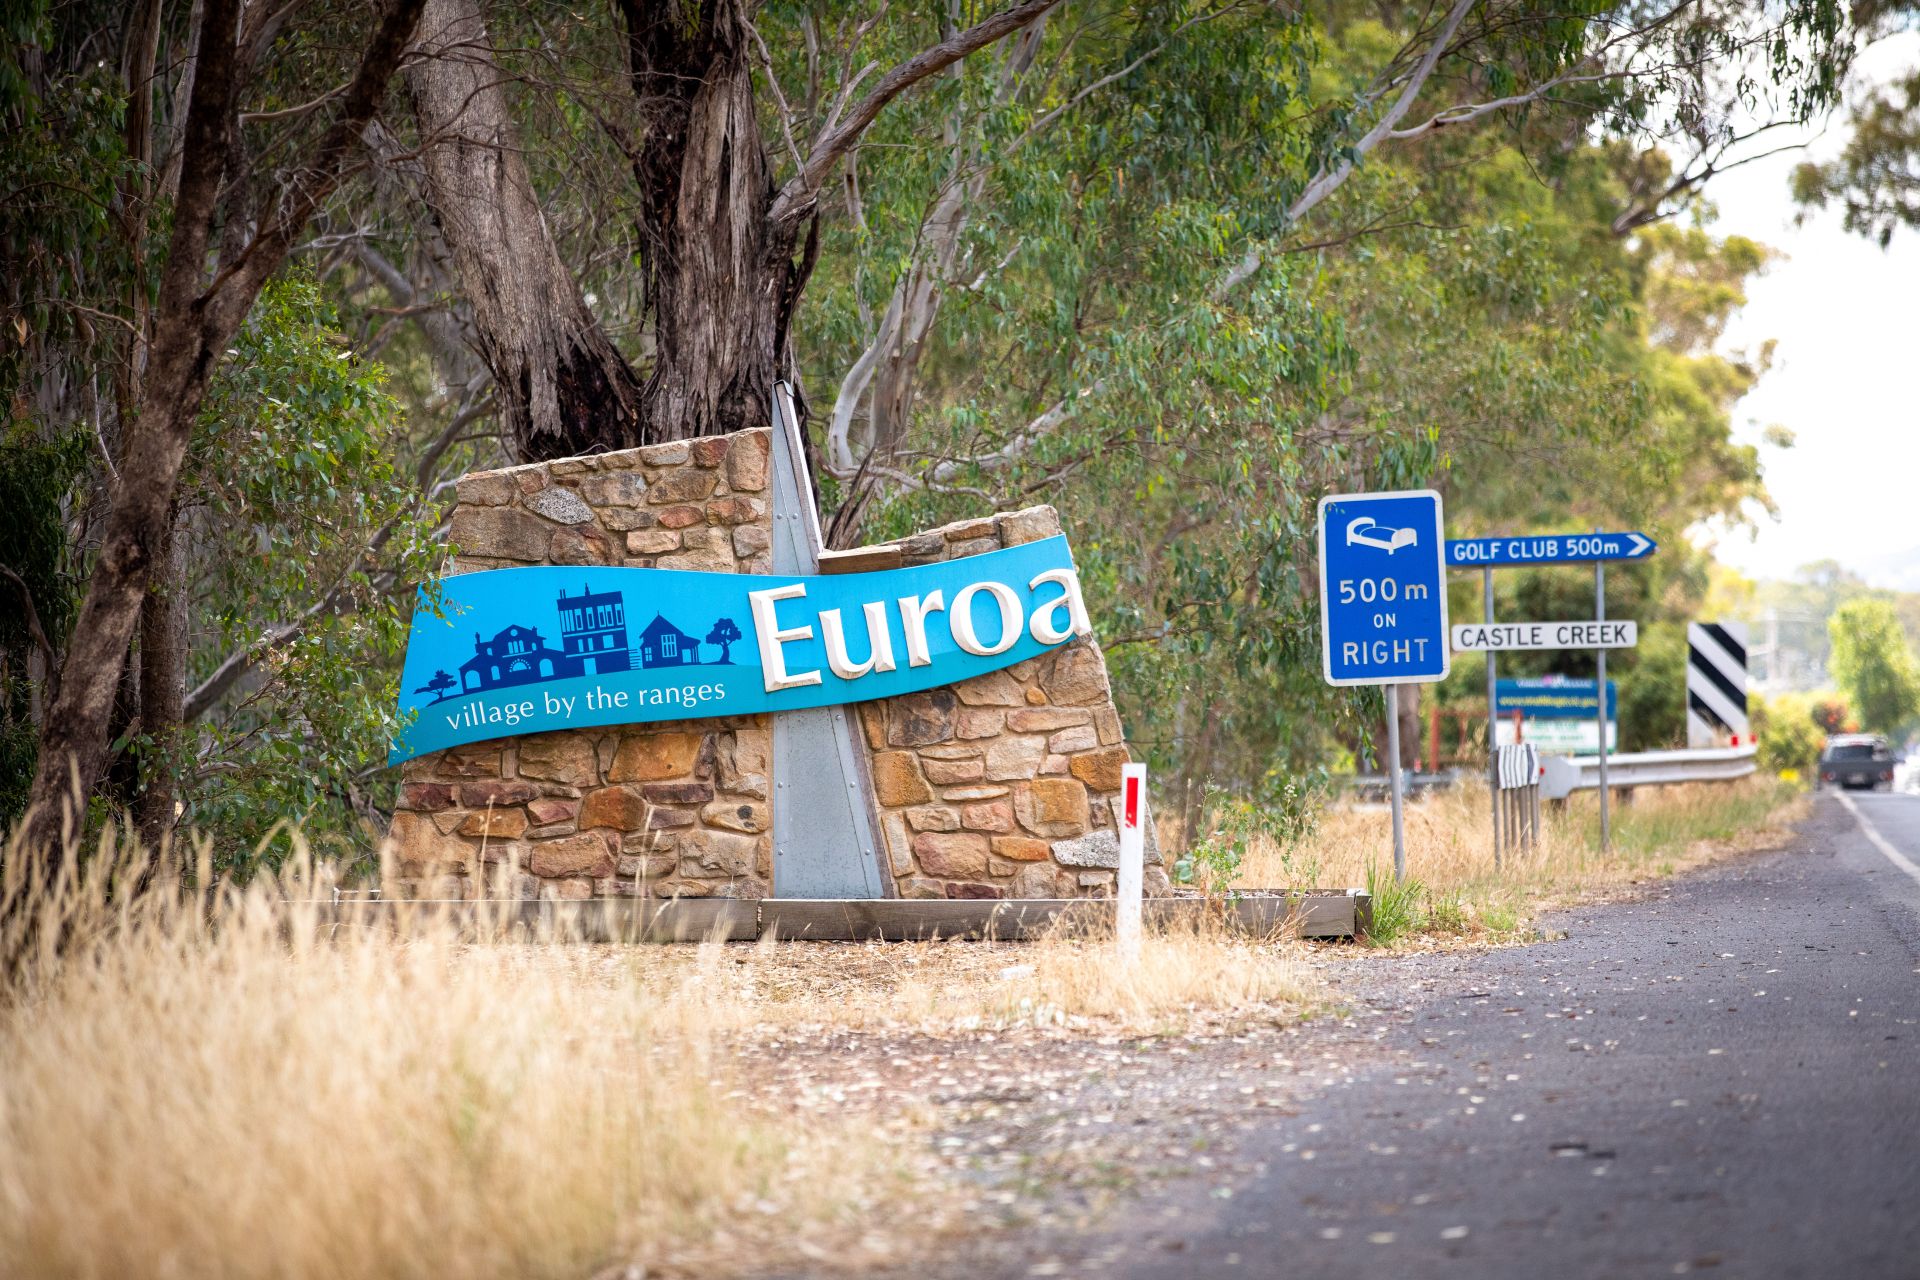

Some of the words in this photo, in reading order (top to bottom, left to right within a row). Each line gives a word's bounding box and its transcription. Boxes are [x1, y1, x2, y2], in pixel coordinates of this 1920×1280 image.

[1454, 543, 1500, 561] GOLF
[1508, 541, 1558, 559] CLUB
[1566, 538, 1620, 557] 500m
[748, 568, 1091, 693] Euroa
[1373, 612, 1396, 628] ON
[1461, 628, 1543, 647] CASTLE
[1556, 624, 1627, 645] CREEK
[1343, 638, 1429, 666] RIGHT
[446, 700, 535, 730] village
[544, 691, 576, 718] by
[586, 686, 629, 710] the
[638, 682, 726, 709] ranges
